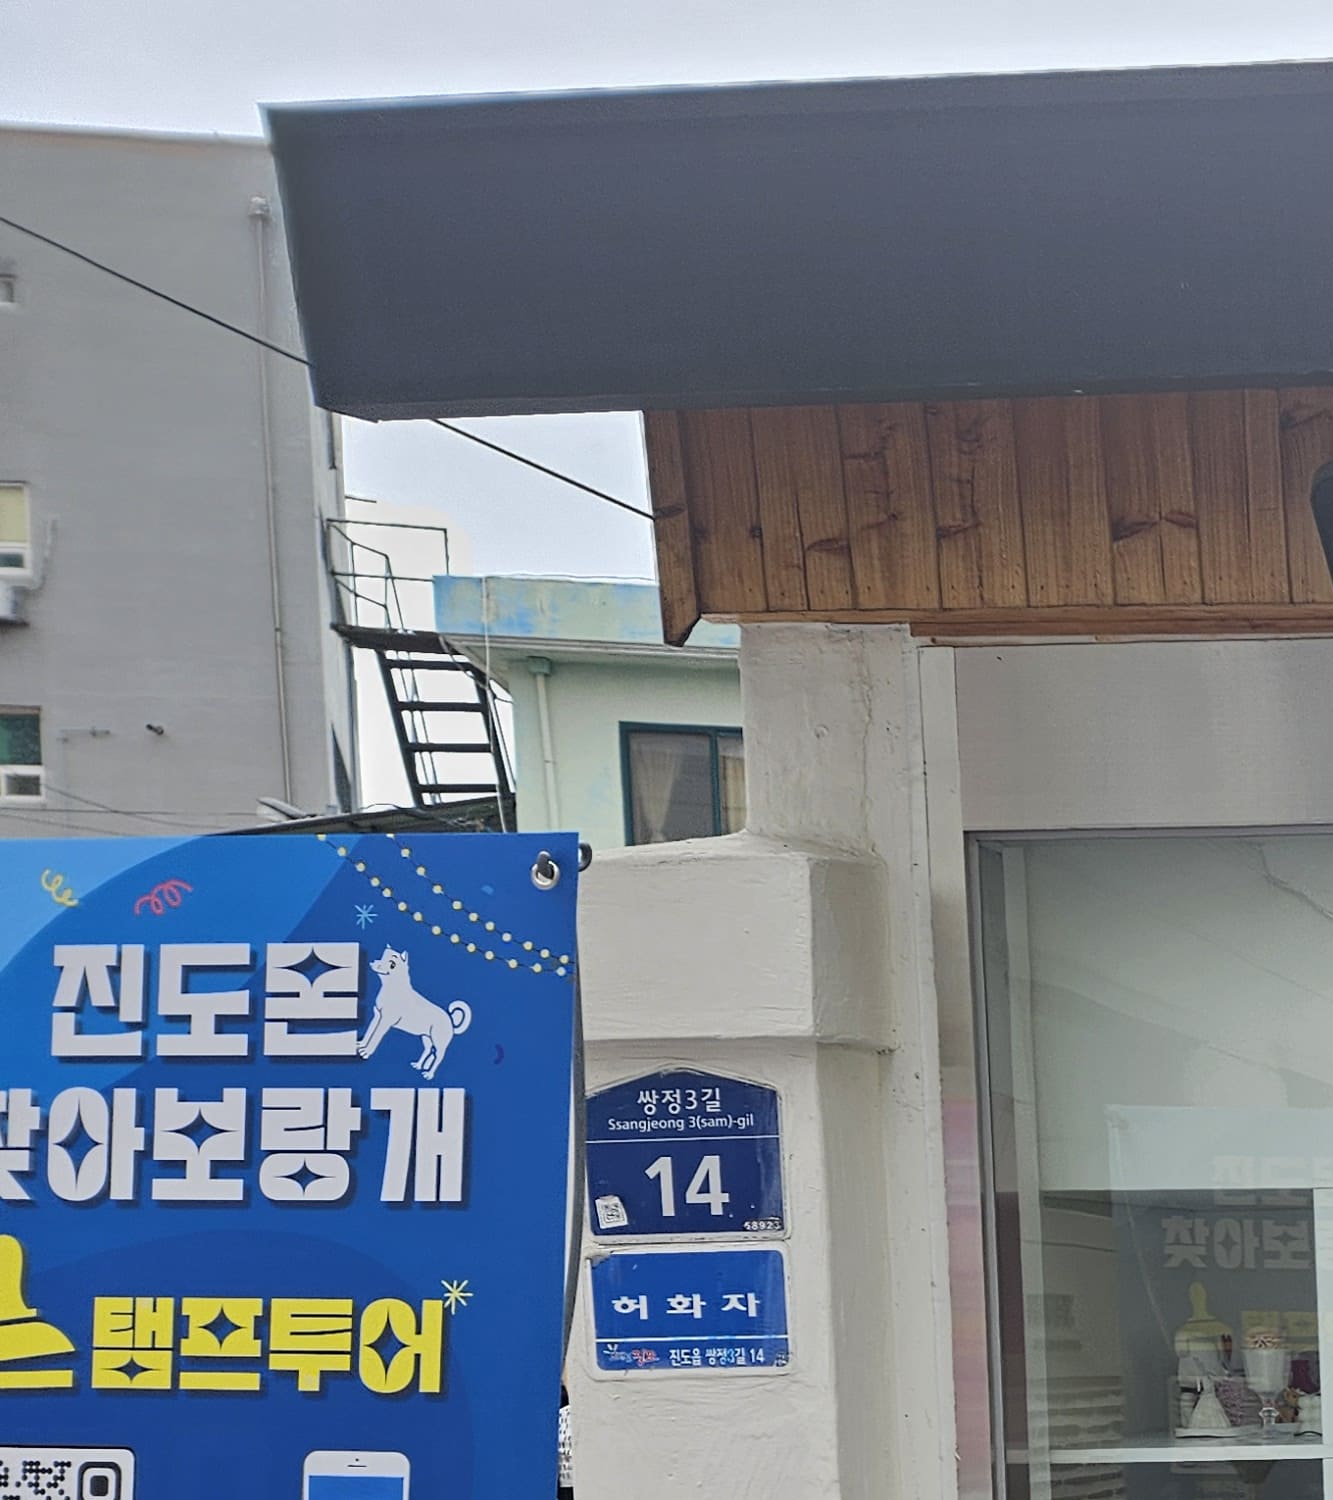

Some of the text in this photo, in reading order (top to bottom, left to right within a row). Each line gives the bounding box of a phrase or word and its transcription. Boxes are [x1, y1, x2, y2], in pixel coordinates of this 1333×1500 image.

[51, 943, 361, 1057] 진도몬
[637, 1088, 721, 1114] 쌍정3길
[608, 1114, 754, 1132] Ssangjeong 3(sam)-gil
[645, 1155, 729, 1217] 14
[669, 1348, 701, 1366] 진도읍
[704, 1347, 746, 1366] 쌍정3길
[749, 1348, 765, 1363] 14
